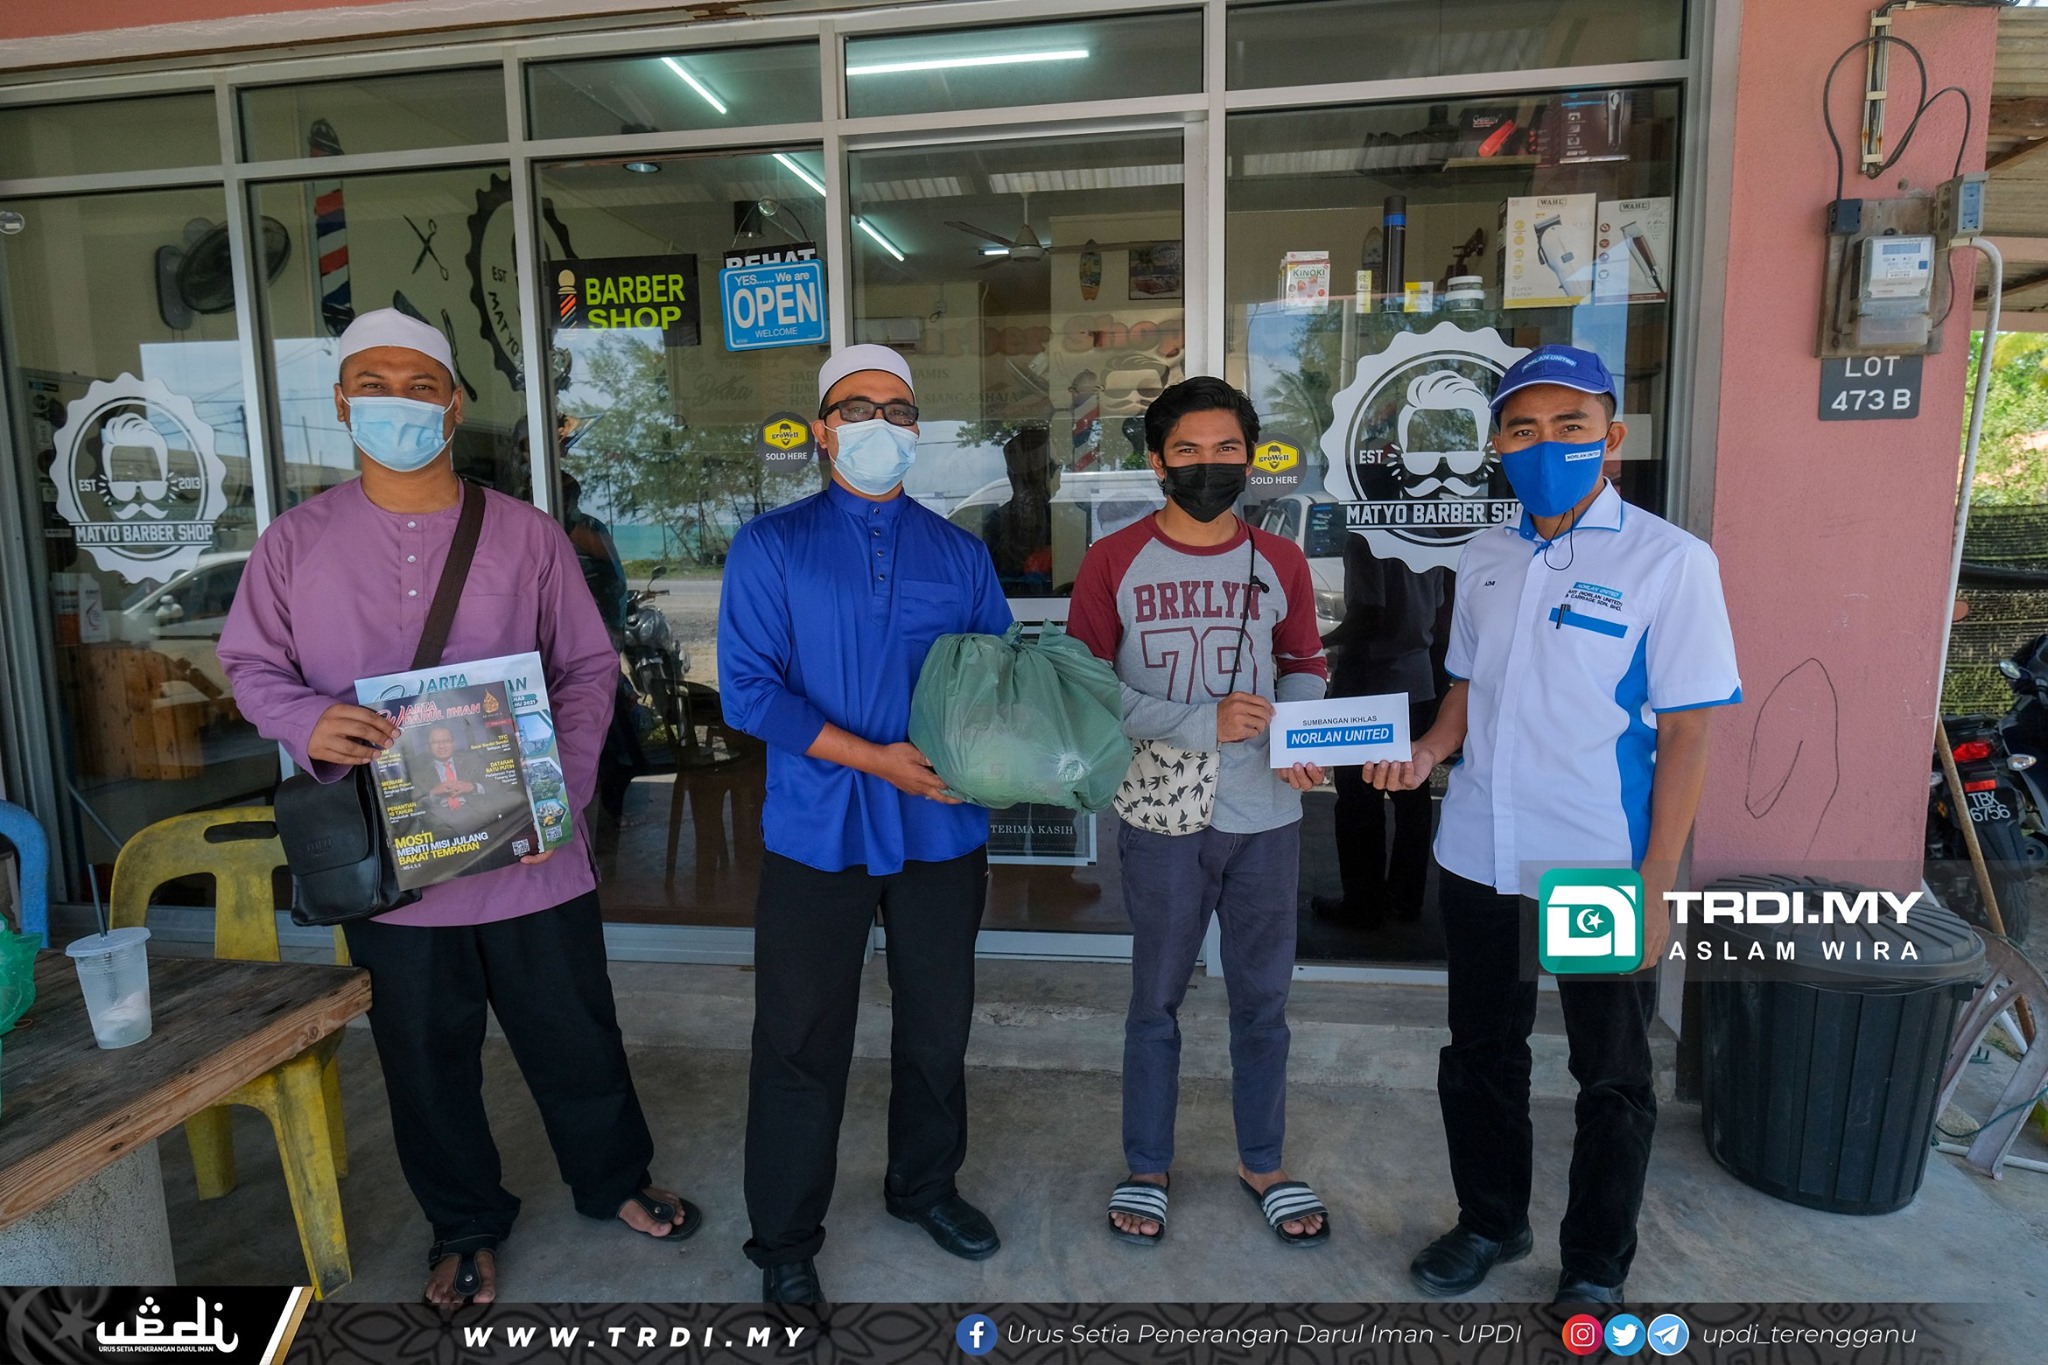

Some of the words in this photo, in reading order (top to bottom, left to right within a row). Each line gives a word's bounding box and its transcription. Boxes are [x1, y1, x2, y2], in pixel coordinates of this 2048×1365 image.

[775, 272, 792, 282] We
[794, 272, 810, 280] are
[1293, 269, 1325, 277] KINOKI
[585, 274, 686, 306] BARBER
[733, 282, 818, 329] OPEN
[588, 306, 682, 333] SHOP
[755, 327, 798, 338] WELCOME
[1844, 355, 1900, 378] LOT
[1831, 390, 1885, 412] 473
[1892, 389, 1911, 410] B
[1359, 449, 1383, 464] EST
[78, 480, 97, 491] EST
[178, 477, 202, 490] 2013
[1251, 477, 1273, 485] SOLD
[1275, 476, 1298, 484] HERE
[1346, 504, 1408, 525] MATYO
[1412, 503, 1486, 524] BARBER
[76, 526, 120, 542] MATYO
[123, 526, 174, 542] BARBER
[178, 524, 214, 541] SHOP
[1133, 580, 1261, 623] BRKLYN
[1302, 718, 1349, 726] SUMBANGAN
[1350, 715, 1378, 723] IKHLAS
[1291, 731, 1342, 744] NORLAN
[1345, 728, 1389, 741] UNITED
[1967, 790, 2000, 808] TBX
[1969, 804, 2011, 822] 6756
[990, 824, 1035, 834] TERIMA
[1038, 825, 1074, 835] KASIH
[395, 832, 434, 849] MOSTI
[397, 844, 429, 858] MENITI
[430, 841, 450, 850] MISI
[451, 832, 489, 847] JULANG
[399, 852, 430, 866] BAKAT
[430, 842, 480, 859] TEMPATAN
